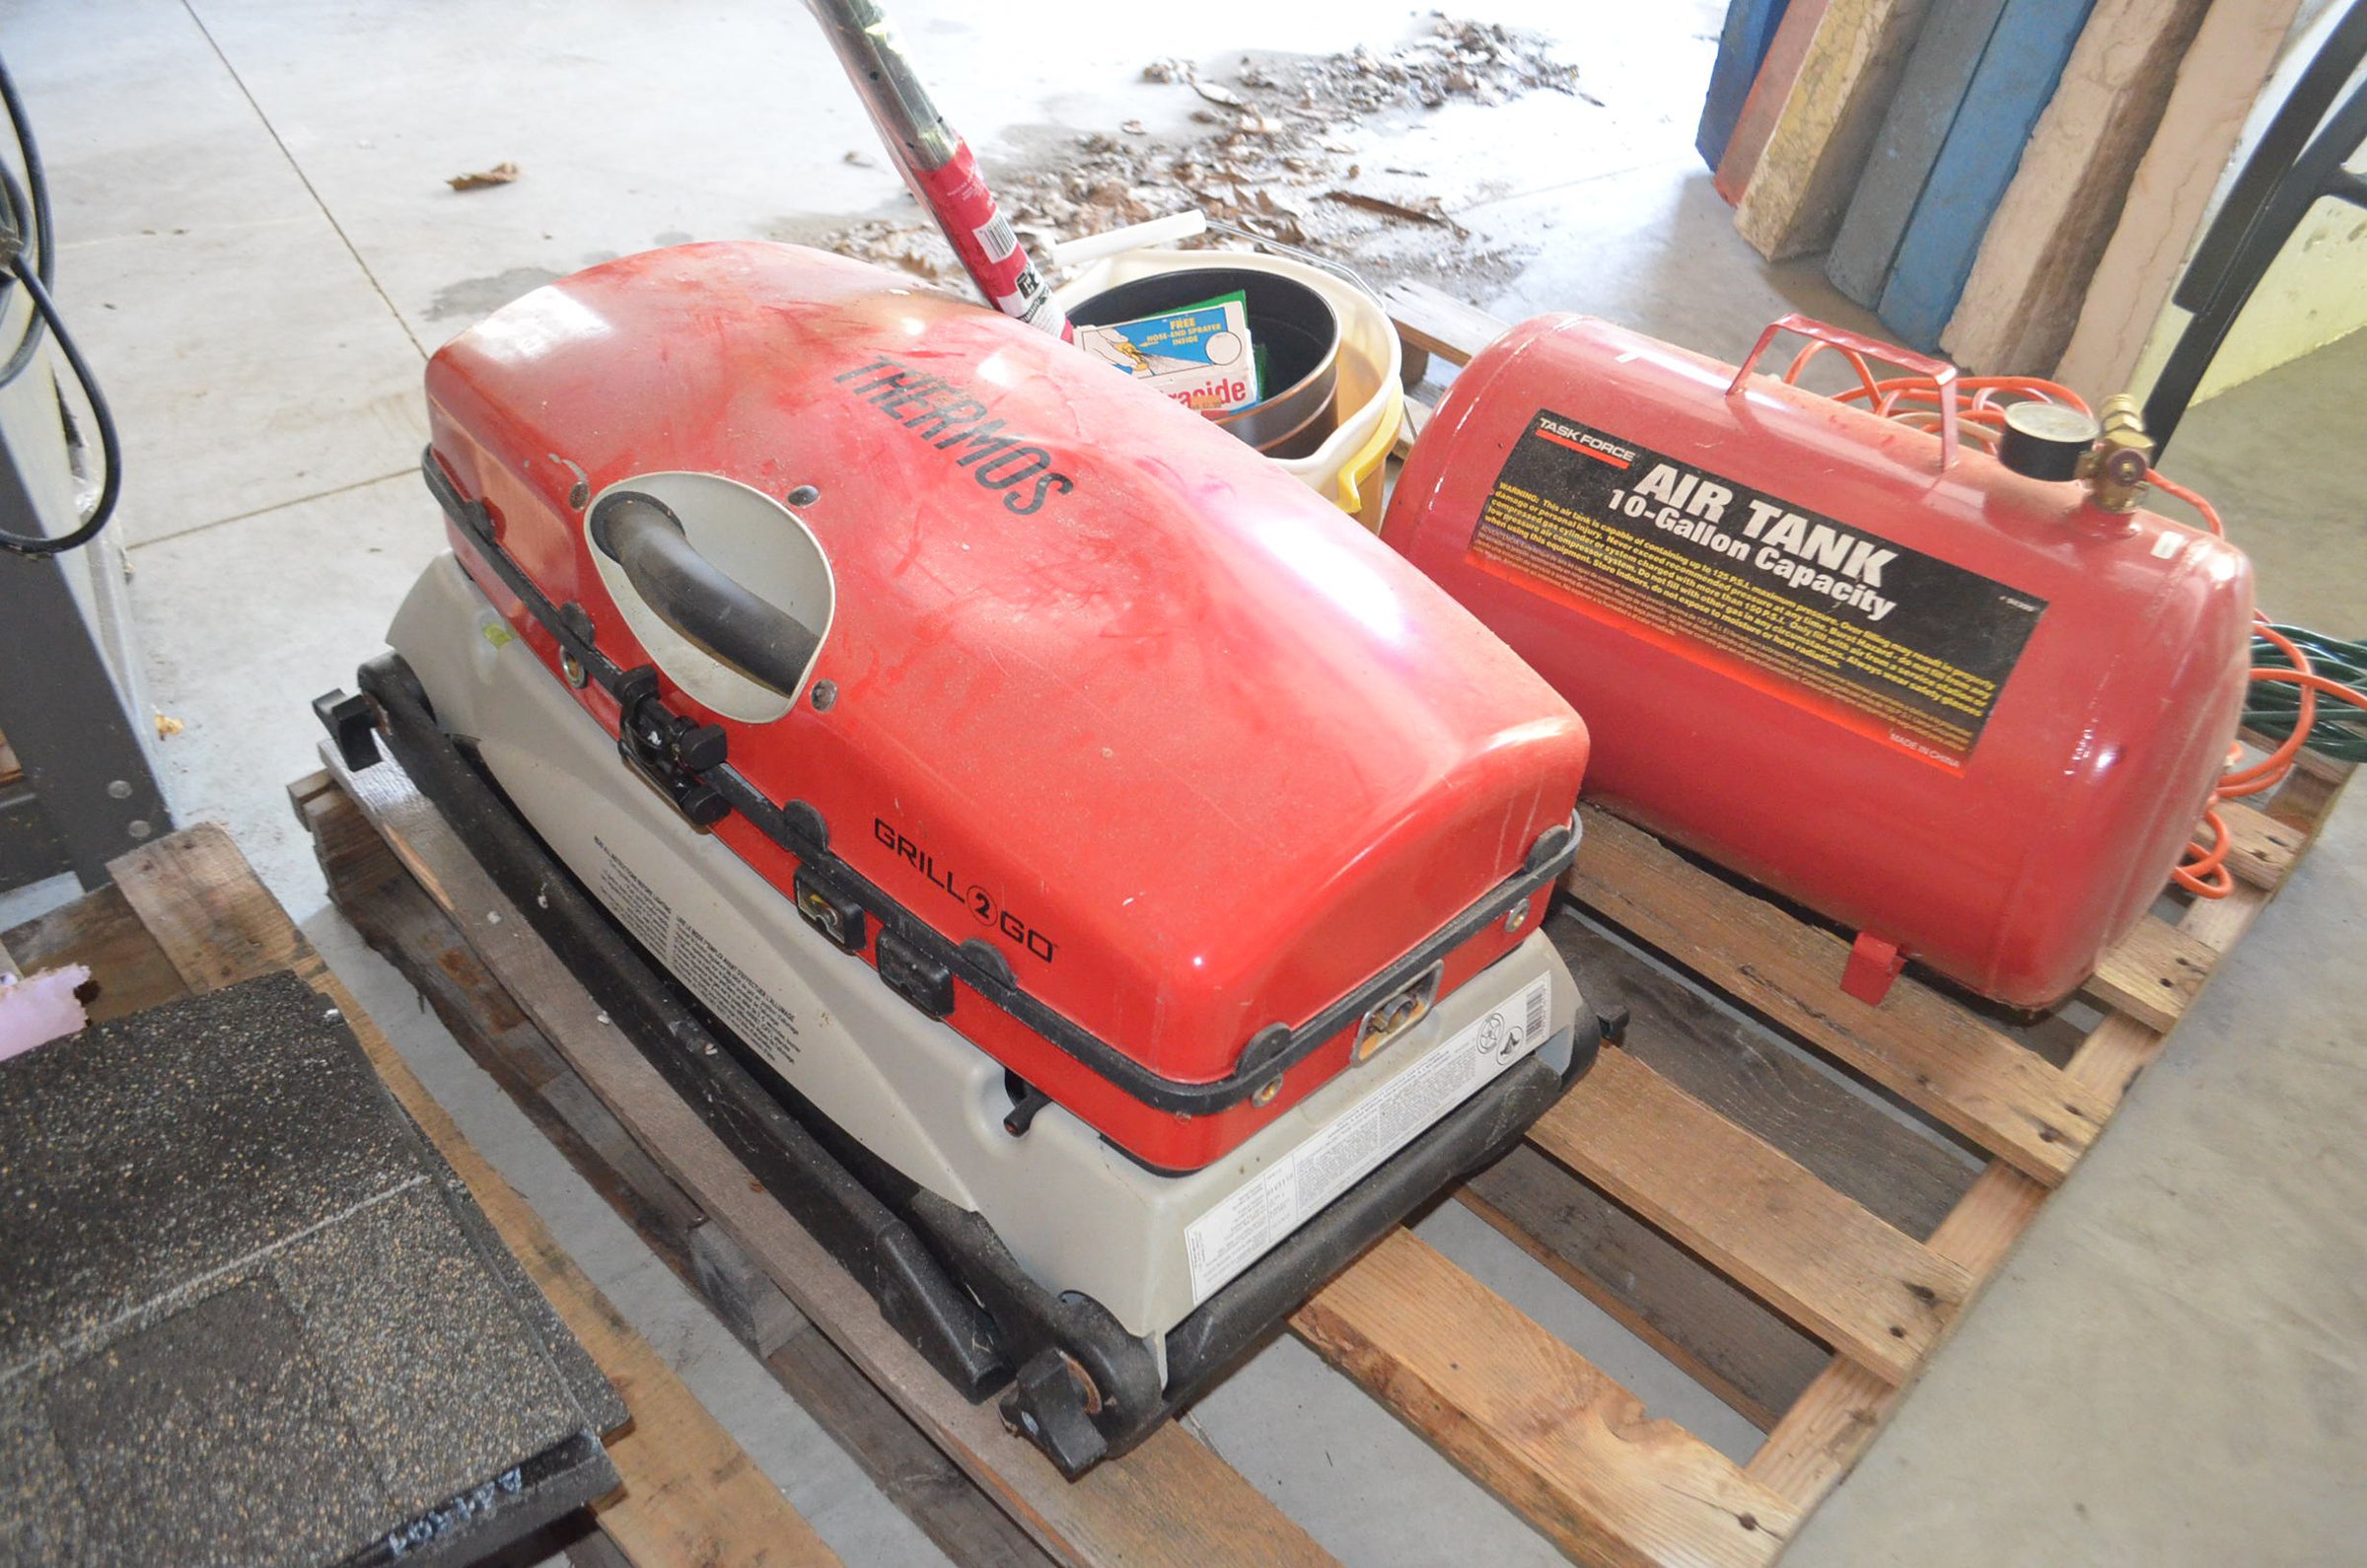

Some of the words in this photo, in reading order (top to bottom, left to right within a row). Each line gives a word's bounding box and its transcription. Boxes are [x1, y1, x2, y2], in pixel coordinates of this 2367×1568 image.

[1170, 318, 1196, 330] FREE
[1173, 335, 1198, 346] INSIDE
[1188, 323, 1222, 335] SPRAYER
[832, 355, 1075, 516] THERMOS
[1168, 378, 1247, 408] acide
[1540, 417, 1581, 441] TASK
[1579, 433, 1636, 463] FORCE
[1483, 514, 1507, 528] when
[1506, 524, 1530, 537] using
[1529, 533, 1545, 543] this
[1544, 539, 1593, 565] equipment.
[1592, 559, 1616, 573] Store
[1614, 569, 1651, 589] indoors,
[1662, 589, 1679, 600] not
[1677, 597, 1710, 614] expose
[1720, 613, 1762, 634] moisture
[1772, 635, 1795, 649] heat
[1487, 506, 1503, 517] low
[1502, 514, 1541, 534] pressure
[1540, 528, 1552, 536] air
[1551, 535, 1603, 559] compressor
[1602, 554, 1637, 574] system.
[1650, 574, 1666, 585] not
[1665, 581, 1680, 590] fill
[1679, 586, 1700, 599] with
[1699, 595, 1726, 609] other
[1724, 606, 1744, 618] gas
[1753, 618, 1771, 630] any
[1771, 624, 1846, 660] circumstances.
[1490, 498, 1542, 525] compressed
[1542, 521, 1559, 532] gas
[1557, 526, 1595, 546] cylinder
[1603, 544, 1637, 563] system
[1635, 558, 1675, 579] charged
[1675, 574, 1696, 587] with
[1695, 584, 1720, 597] more
[1720, 593, 1744, 606] than
[1743, 603, 1762, 614] 150
[1494, 490, 1529, 509] damage
[1538, 508, 1576, 529] personal
[1575, 524, 1604, 539] injury.
[1606, 535, 1633, 550] Never
[1631, 546, 1666, 564] exceed
[1665, 560, 1731, 591] recommended
[1729, 588, 1772, 609] pressure
[1783, 610, 1803, 622] any
[1542, 499, 1561, 511] This
[1559, 507, 1572, 516] air
[1571, 512, 1592, 524] tank
[1599, 523, 1634, 542] capable
[1642, 540, 1689, 565] containing
[1711, 569, 1729, 580] 125
[1751, 585, 1797, 608] maximum
[1608, 488, 1752, 561] 10-Gallon
[1755, 546, 1897, 621] Capacity
[1632, 463, 1734, 524] AIR
[1742, 499, 1899, 588] TANK
